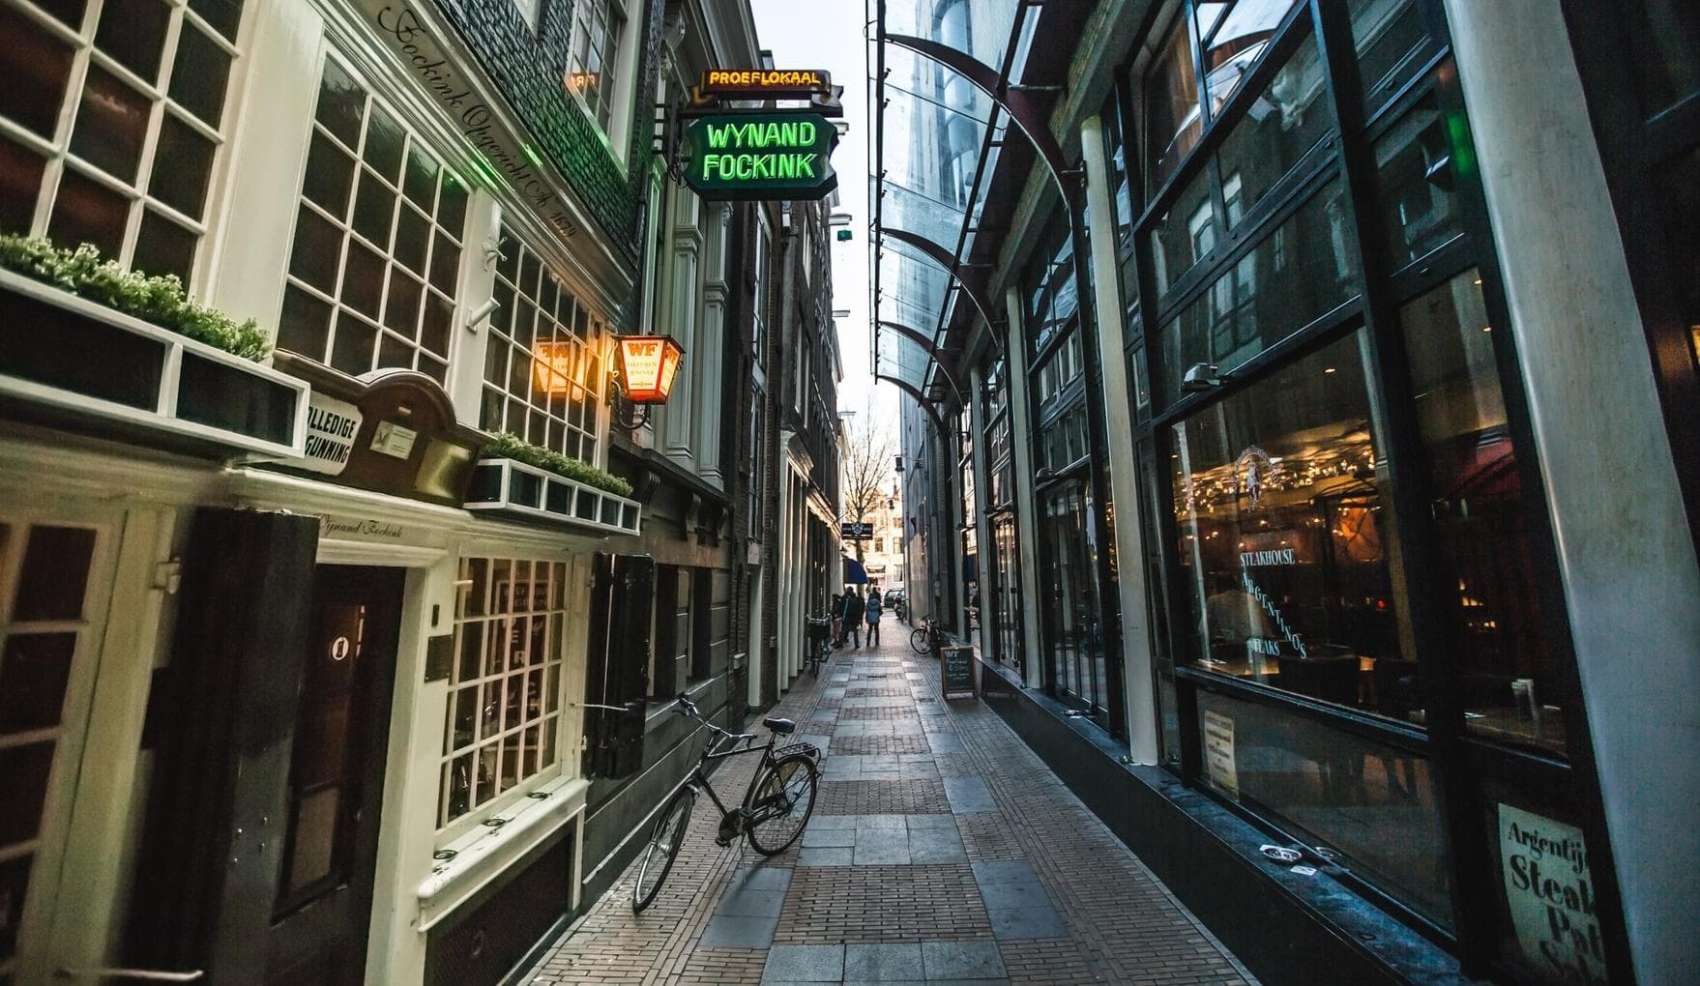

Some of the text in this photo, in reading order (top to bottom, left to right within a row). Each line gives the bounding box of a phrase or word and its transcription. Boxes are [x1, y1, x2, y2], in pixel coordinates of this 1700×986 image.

[709, 71, 821, 85] PROEFLOKAAL
[377, 6, 470, 109] Fockink
[549, 212, 577, 238] 1679
[706, 121, 816, 148] WYNAND
[703, 153, 818, 181] FOCKINK
[627, 342, 658, 357] WF
[1240, 548, 1295, 567] STEAKHOUSE
[1242, 571, 1307, 660] ARGENTINOS
